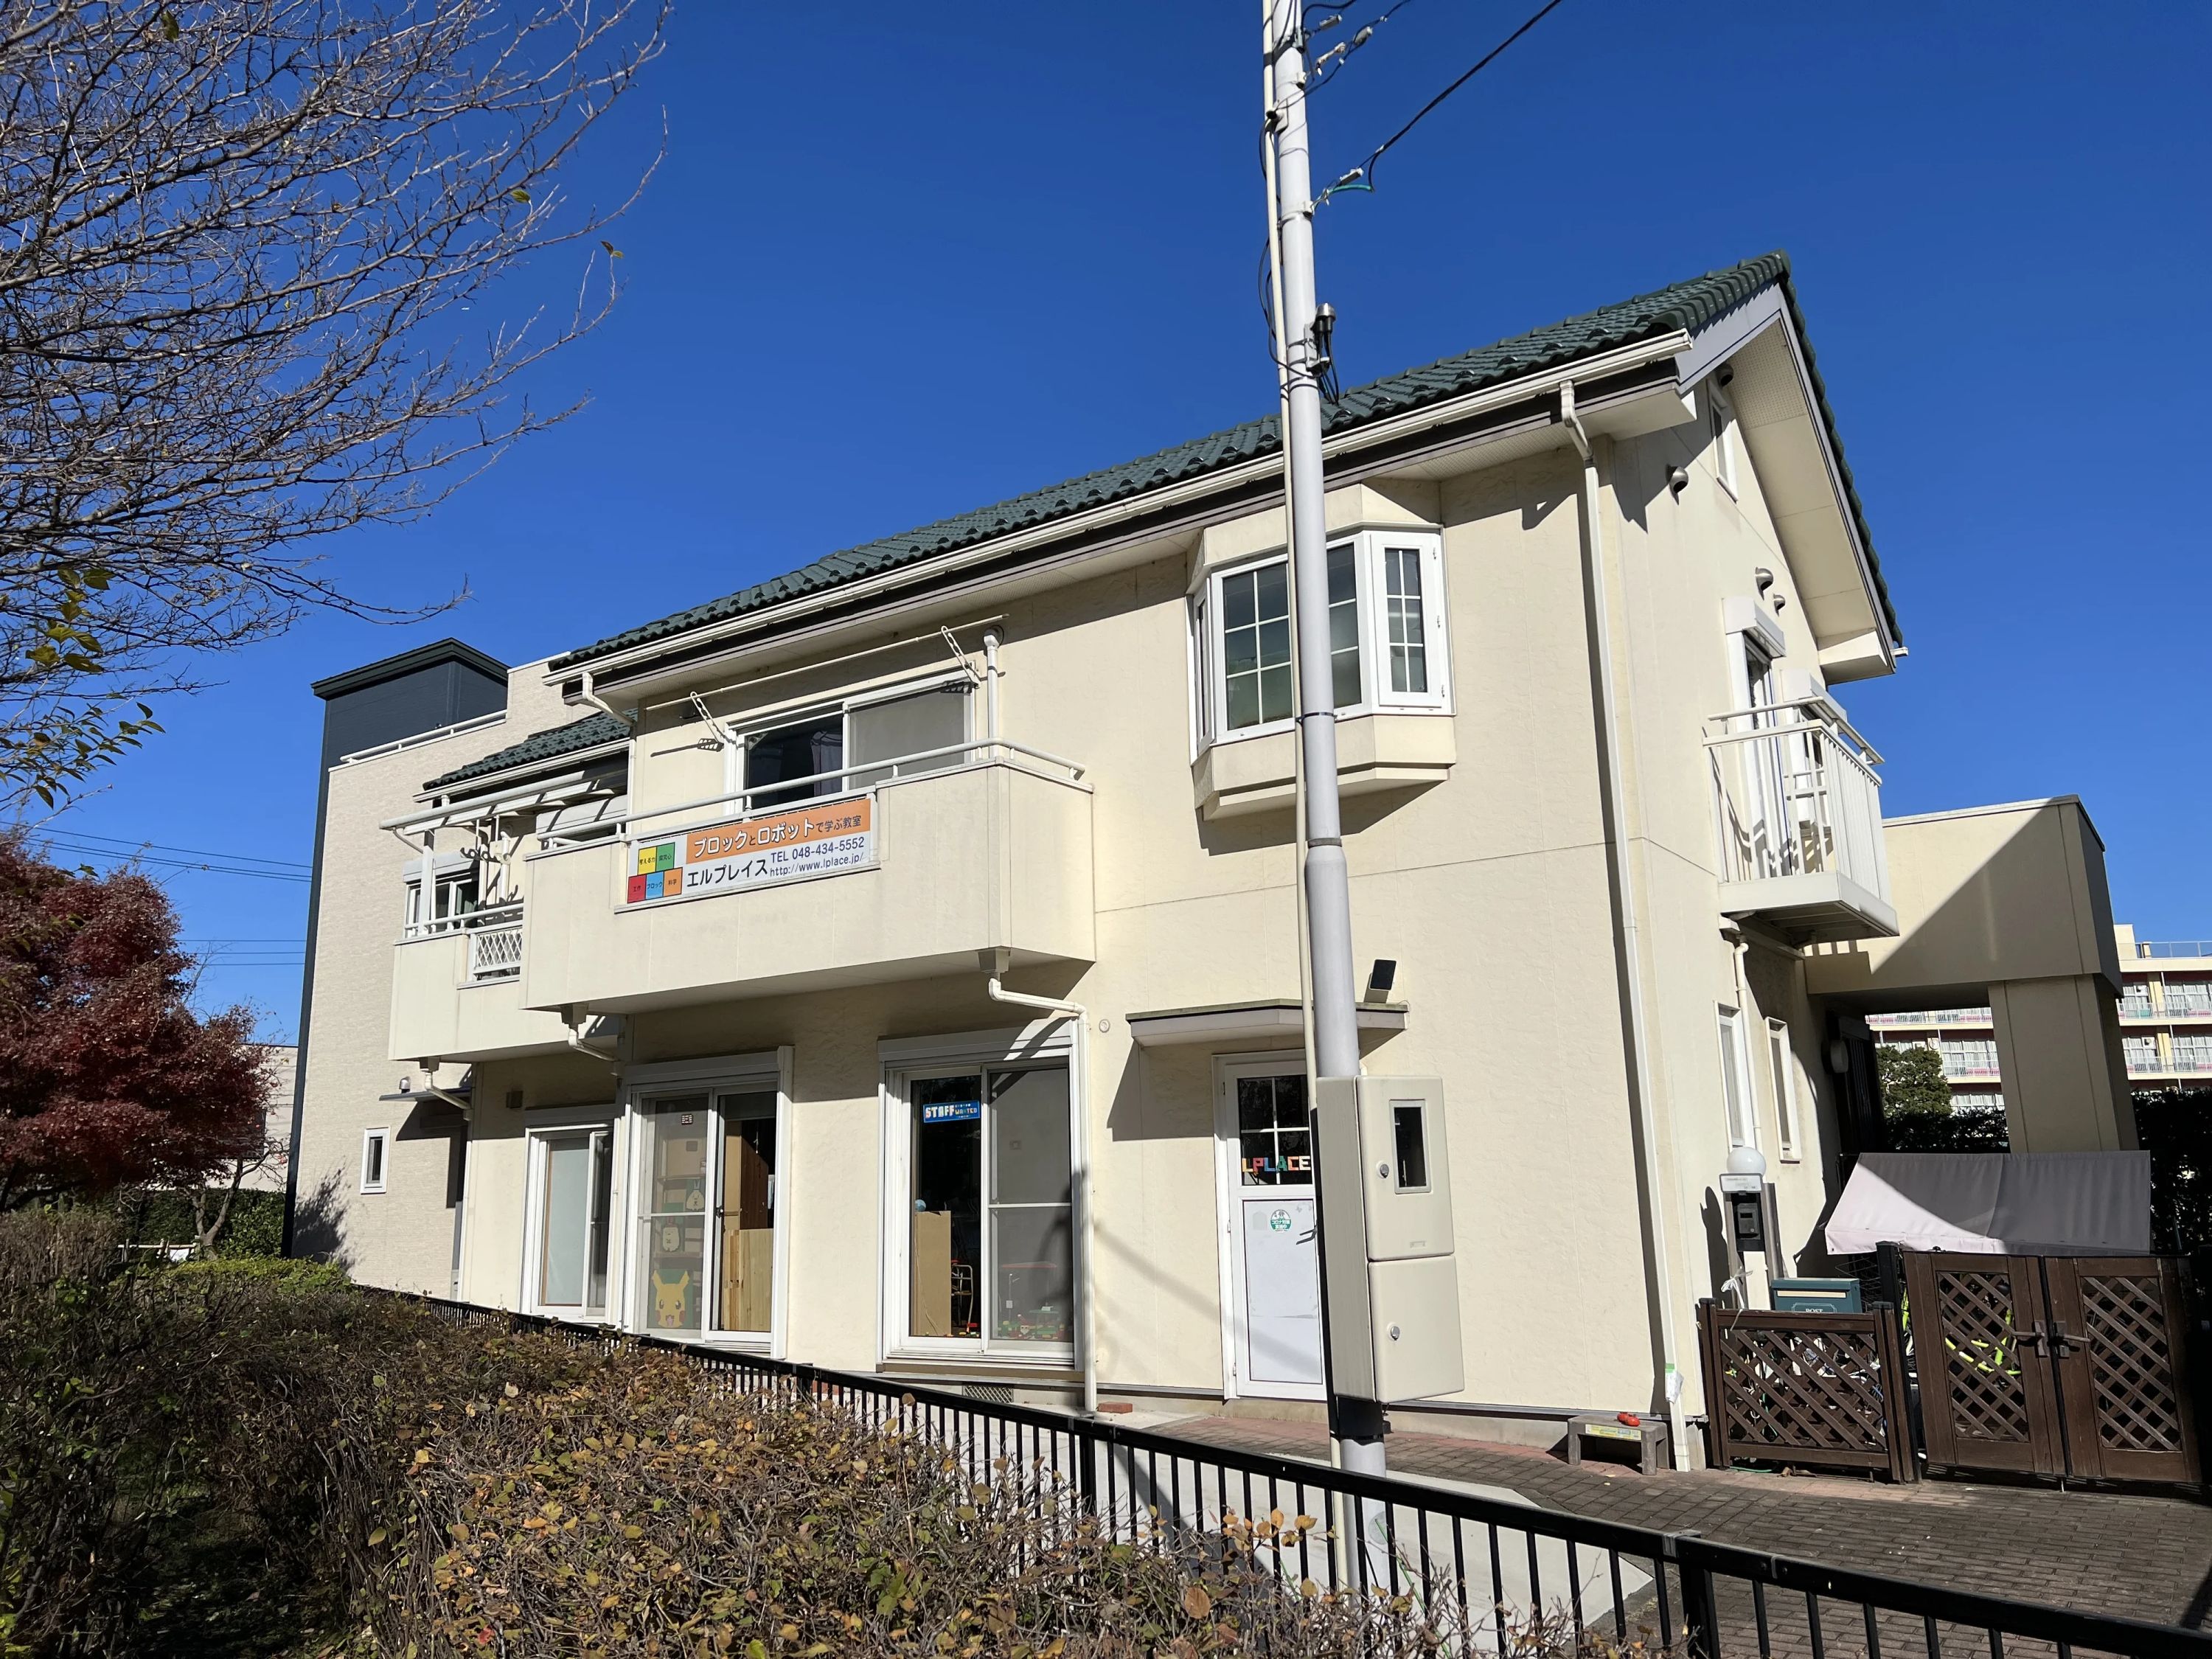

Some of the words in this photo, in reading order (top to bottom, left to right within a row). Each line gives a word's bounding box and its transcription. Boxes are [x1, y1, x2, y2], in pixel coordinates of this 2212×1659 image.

[694, 815, 862, 858] ブロックとロボットで学ぶ教室
[771, 852, 789, 863] TEL
[792, 836, 865, 860] 048-434-5552
[686, 859, 768, 887] エルプレイス
[769, 852, 864, 877] http://www.lplace.jp/
[925, 1105, 955, 1119] STAFF
[1242, 1155, 1311, 1172] LPLACE
